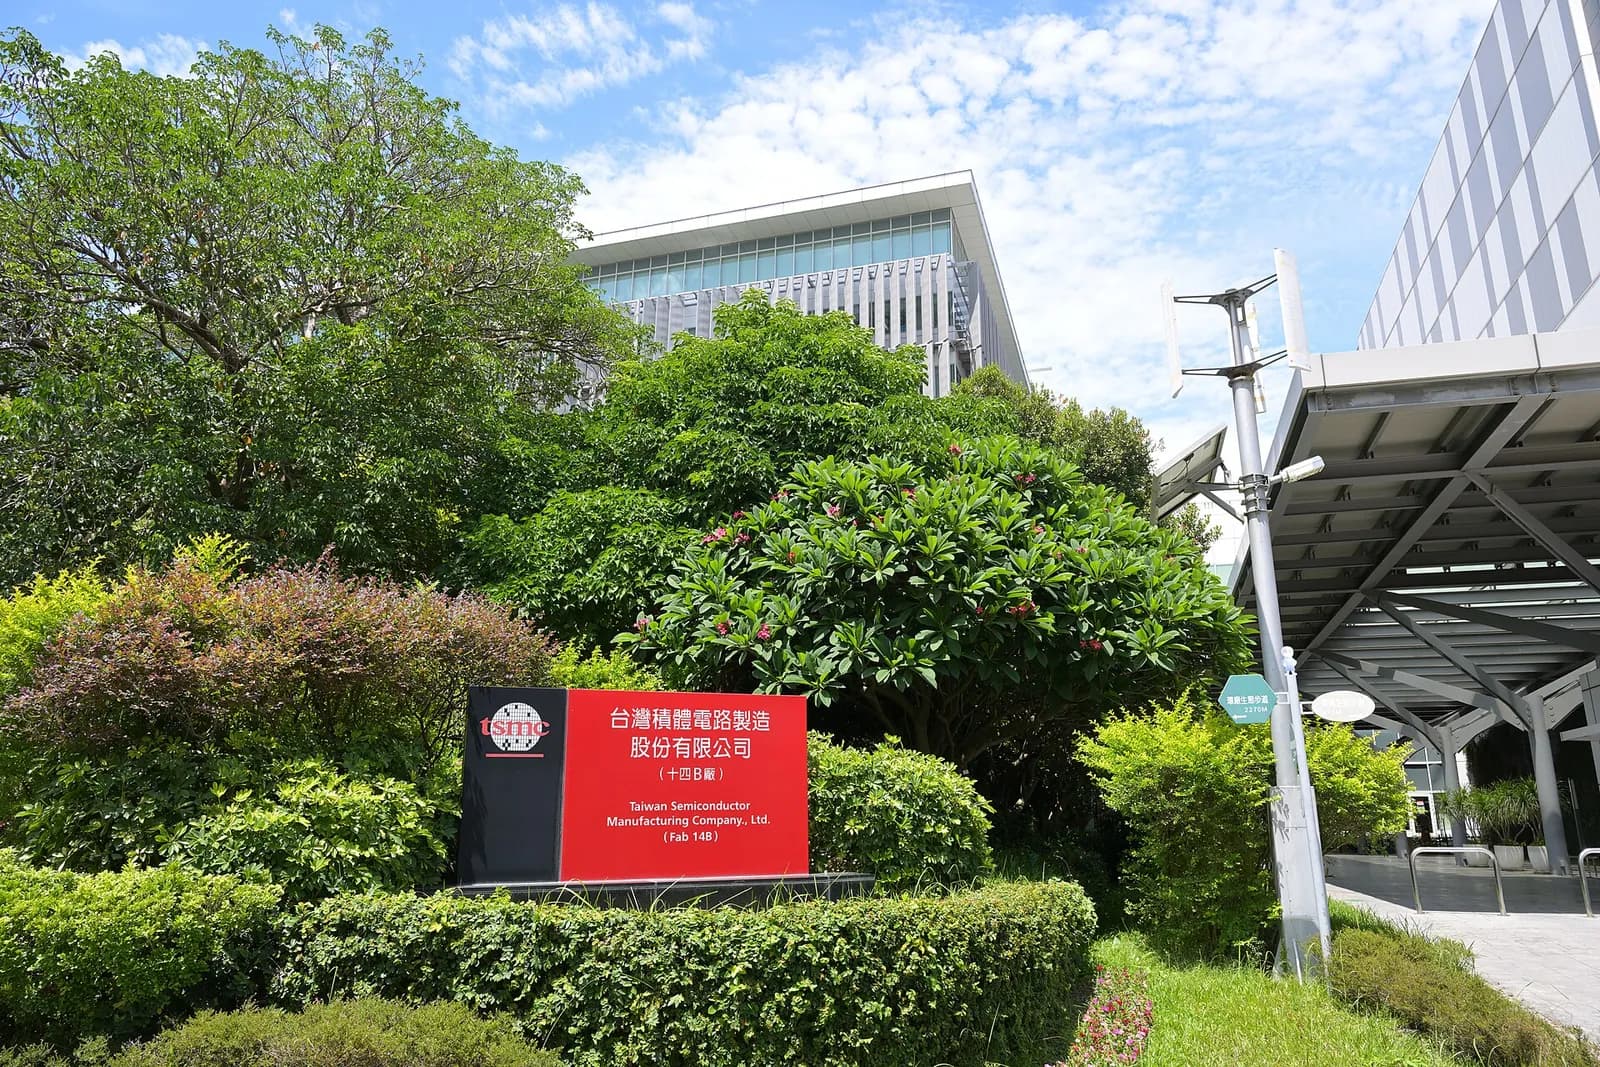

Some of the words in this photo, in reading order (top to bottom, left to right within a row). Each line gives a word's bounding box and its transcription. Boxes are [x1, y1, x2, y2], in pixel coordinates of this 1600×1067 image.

[480, 717, 550, 736] tsmc
[611, 707, 770, 731] 台灣積體電路製造
[631, 736, 751, 759] 股份有限公司
[629, 801, 667, 812] Taiwan
[671, 801, 751, 811] Semiconductor
[607, 816, 689, 828] Manufacturing
[692, 815, 748, 827] Company.,
[751, 814, 771, 825] Ltd.
